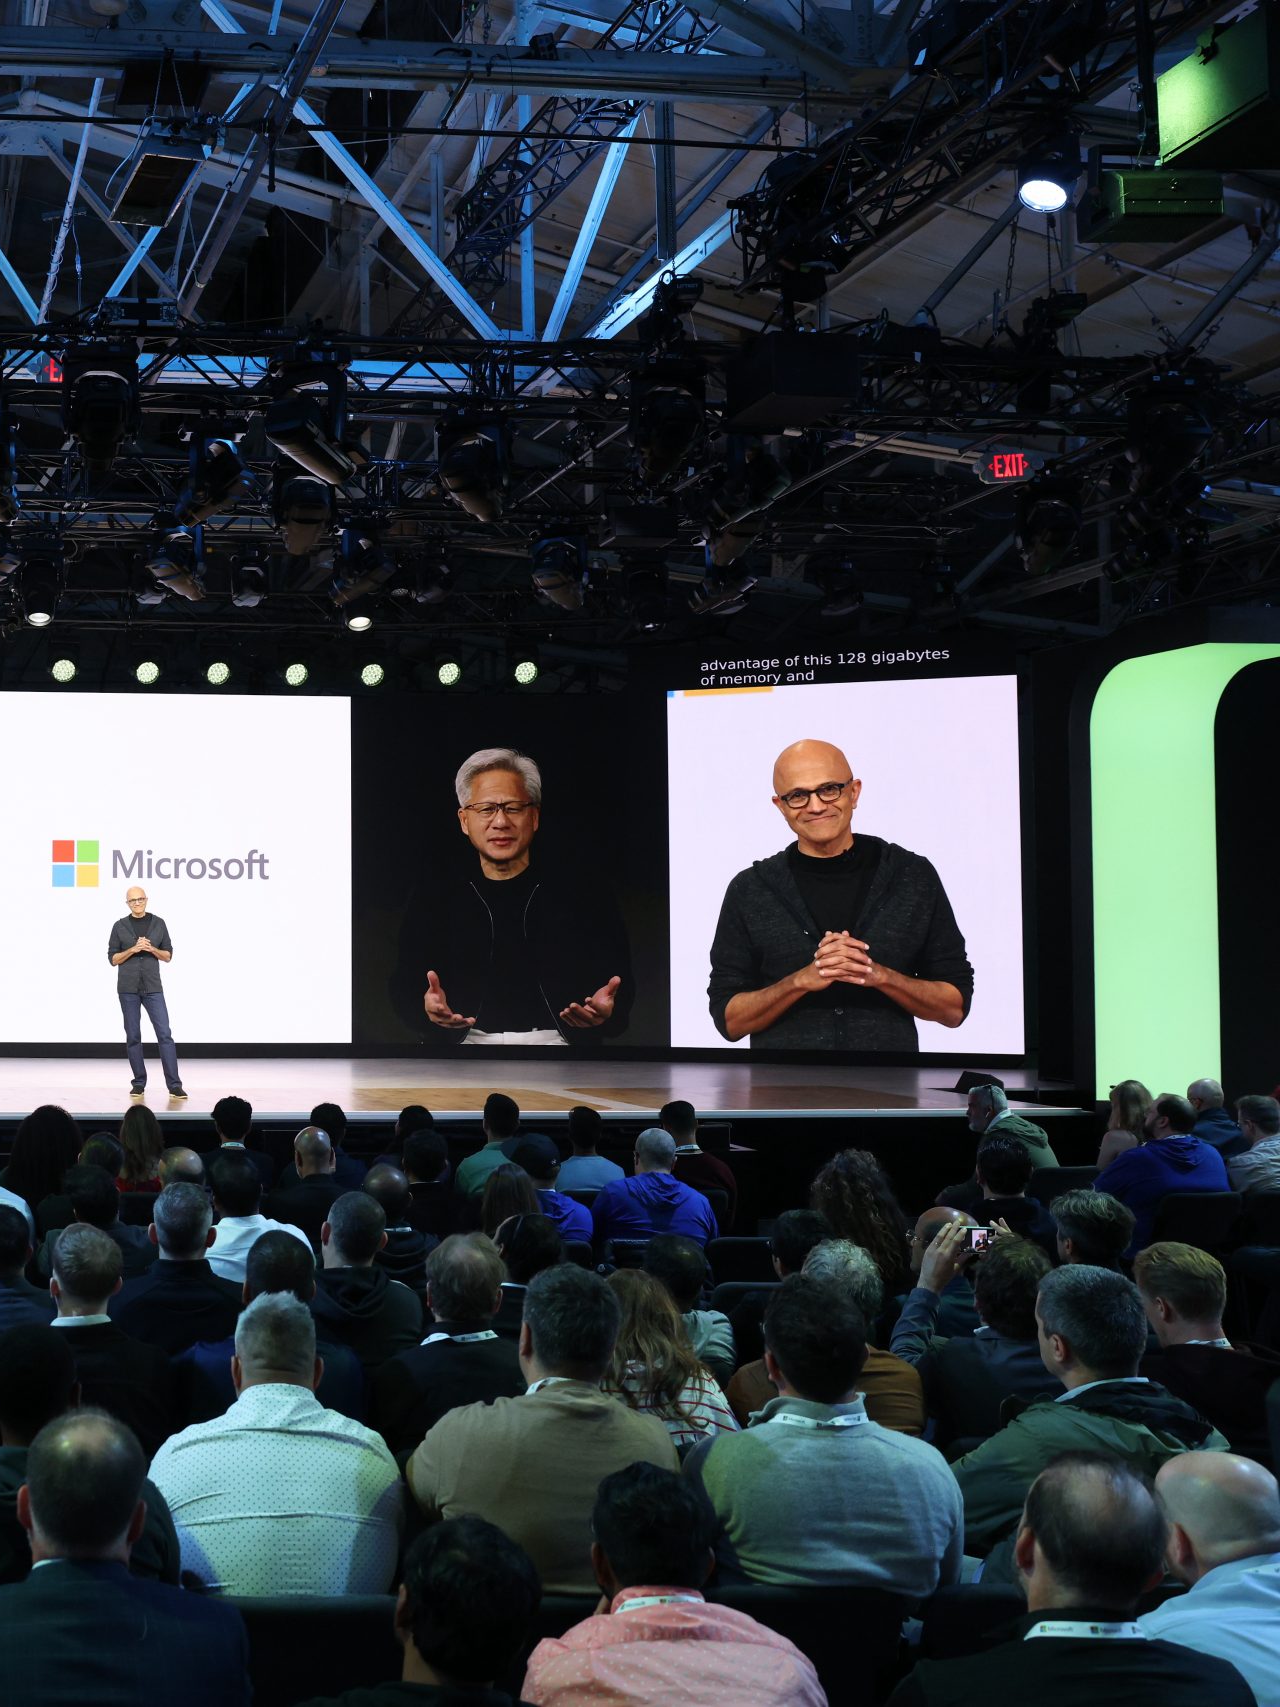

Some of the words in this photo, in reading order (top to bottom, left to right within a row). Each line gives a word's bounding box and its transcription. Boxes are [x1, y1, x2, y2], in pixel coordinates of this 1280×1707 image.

[993, 453, 1024, 478] EXIT
[700, 658, 780, 672] advantage
[784, 655, 800, 667] of
[803, 654, 832, 666] this
[837, 652, 866, 664] 128
[871, 649, 950, 665] gigabytes
[700, 674, 716, 686] of
[719, 673, 782, 685] memory
[786, 669, 815, 682] and
[112, 848, 270, 881] Microsoft
